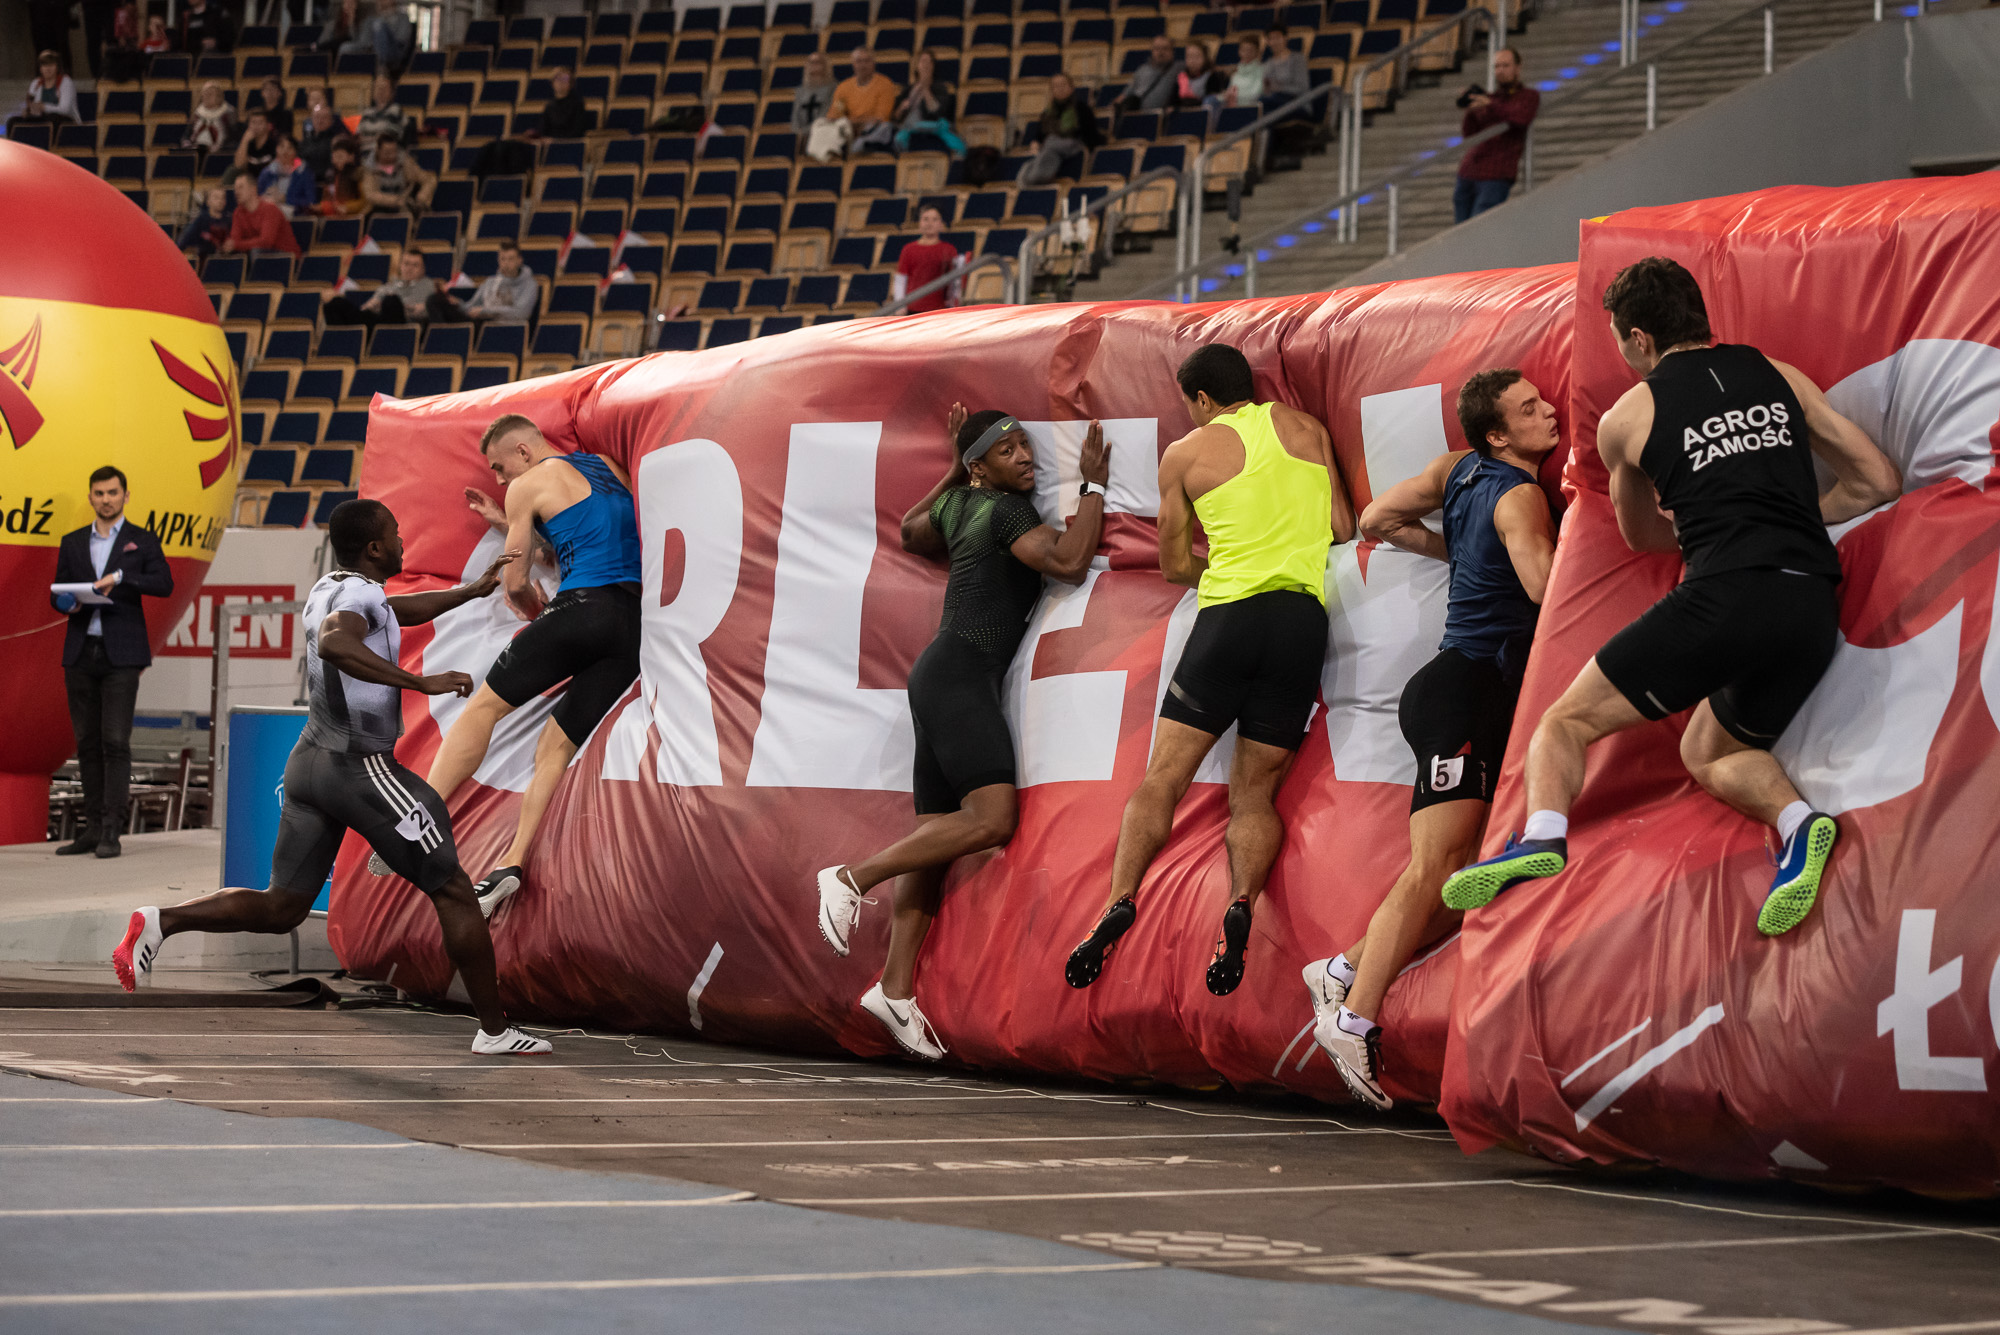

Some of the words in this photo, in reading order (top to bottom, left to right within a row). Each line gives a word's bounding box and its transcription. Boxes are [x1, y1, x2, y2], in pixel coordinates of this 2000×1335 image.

[1684, 402, 1790, 452] AGROS
[1688, 425, 1793, 472] ZAMOŚĆ
[1434, 762, 1450, 788] 5
[409, 809, 430, 833] 2
[1877, 908, 2000, 1092] Ł
